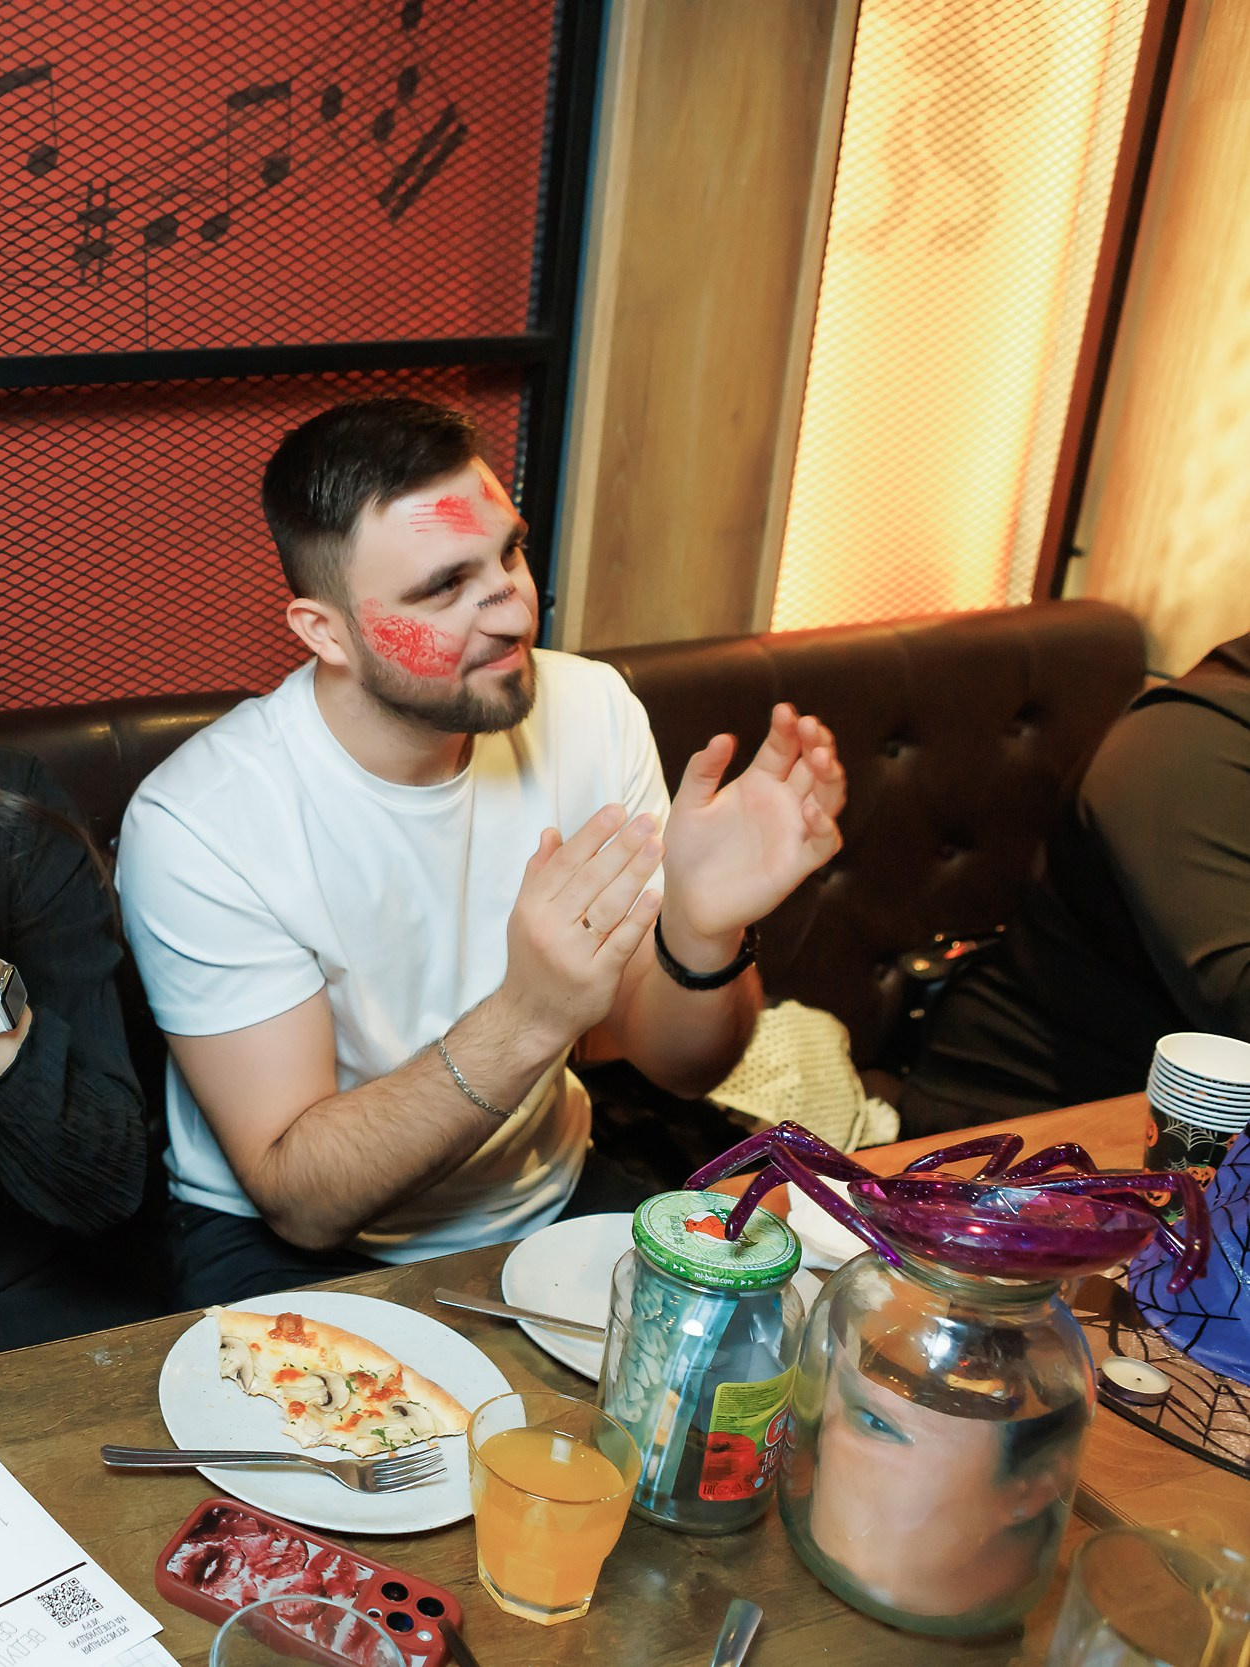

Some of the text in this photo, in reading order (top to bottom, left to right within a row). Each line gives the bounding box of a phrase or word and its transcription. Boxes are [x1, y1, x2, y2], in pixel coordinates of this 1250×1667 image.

[694, 1271, 735, 1286] ml-best.com
[68, 1614, 127, 1649] НА СЛЕДУЮЩУЮ
[82, 1617, 100, 1631] ИГРУ
[82, 1625, 129, 1655] РЕГИСТРАЦИЯ
